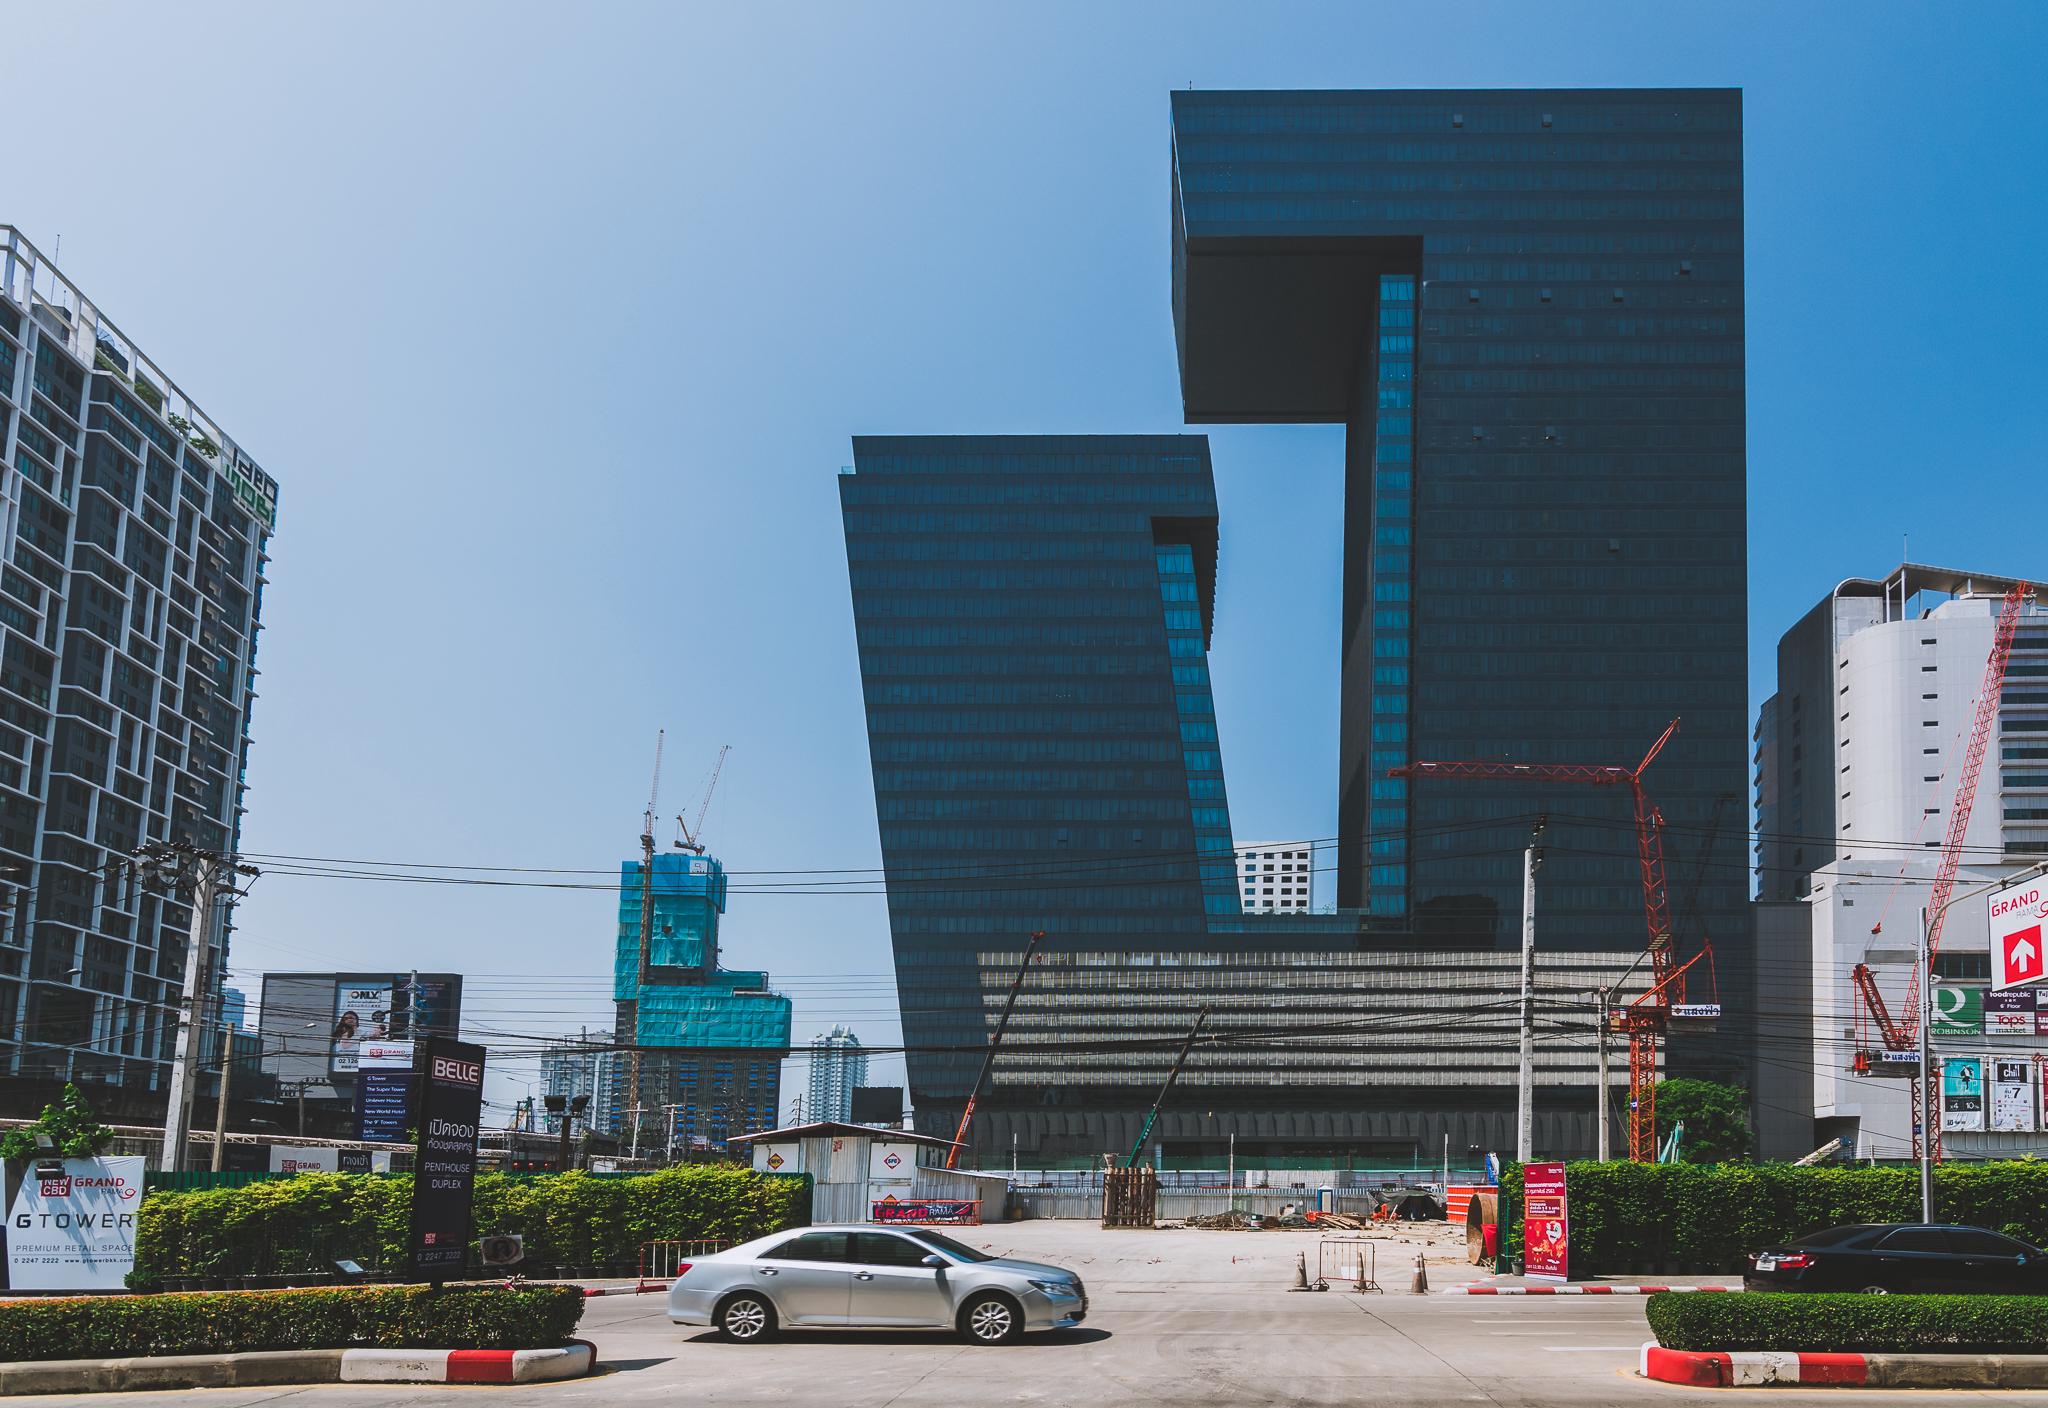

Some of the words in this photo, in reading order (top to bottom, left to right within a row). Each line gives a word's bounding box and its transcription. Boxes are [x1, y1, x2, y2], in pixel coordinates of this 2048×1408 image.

[1991, 890, 2039, 917] GRAND
[2016, 905, 2038, 918] RAMA
[1995, 1015, 2026, 1028] Tops
[434, 1059, 478, 1082] BELLE
[429, 1118, 474, 1138] เปิดจอง
[297, 1162, 321, 1170] GRAND
[424, 1161, 470, 1173] PENTHOUSE
[75, 1178, 125, 1187] GRAND
[432, 1179, 461, 1189] DUPLEX
[43, 1186, 67, 1195] CBD
[874, 1207, 928, 1218] GRAND
[16, 1214, 32, 1228] G
[38, 1213, 132, 1228] TOWER
[101, 1244, 133, 1252] SPACE
